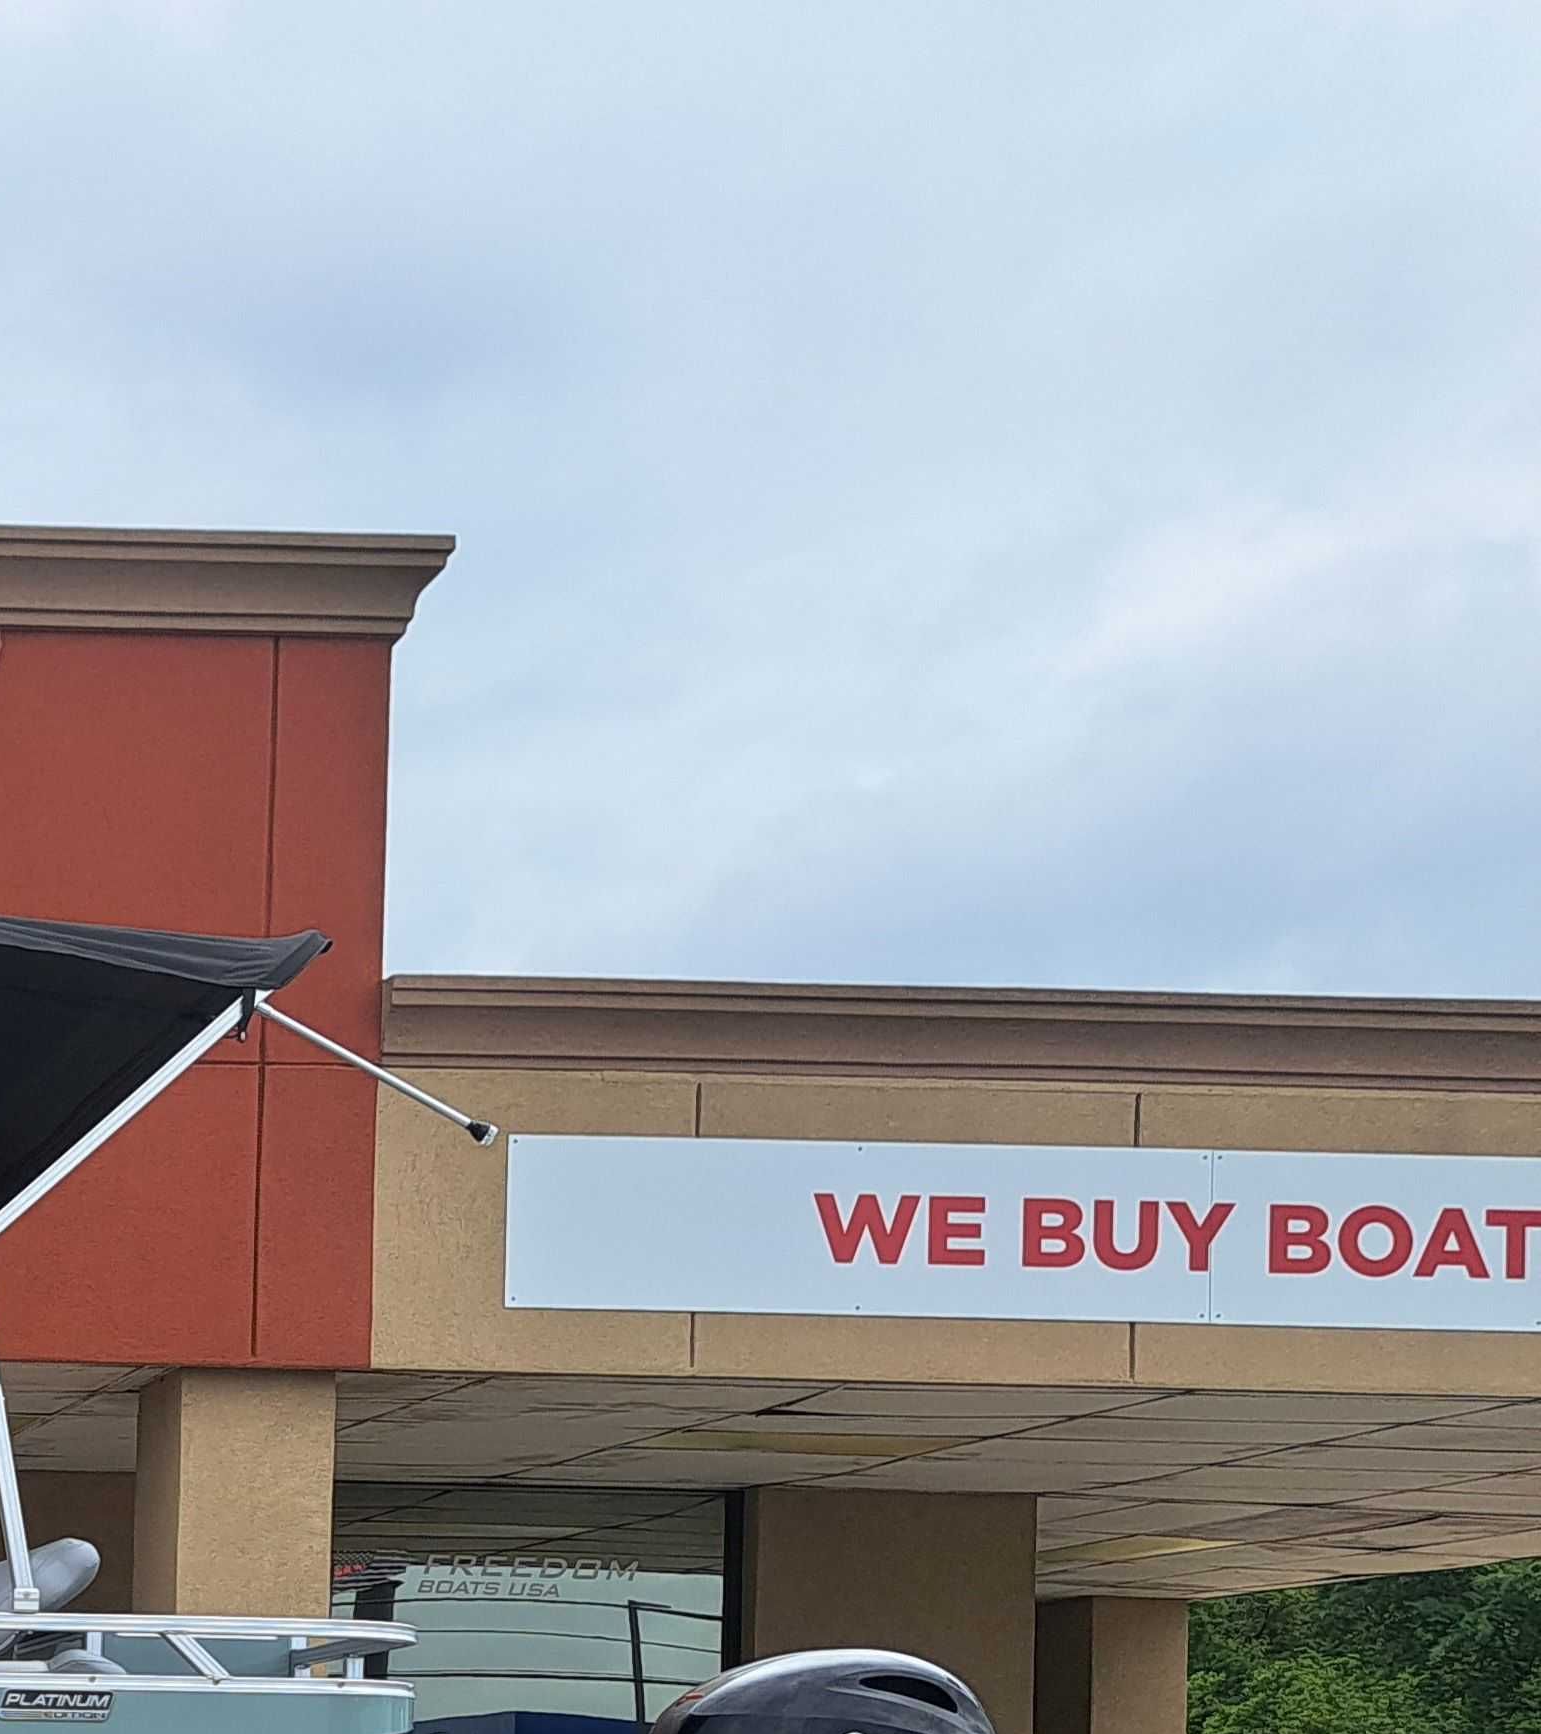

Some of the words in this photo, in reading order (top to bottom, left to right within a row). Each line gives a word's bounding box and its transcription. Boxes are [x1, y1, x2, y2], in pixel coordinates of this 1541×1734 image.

[814, 1193, 986, 1266] WE
[1021, 1197, 1236, 1273] BUY
[1268, 1203, 1541, 1281] BOAT
[423, 1554, 639, 1581] FREEDOM
[418, 1580, 500, 1596] BOATS
[508, 1583, 561, 1598] USA
[5, 1692, 111, 1708] PLATINUM
